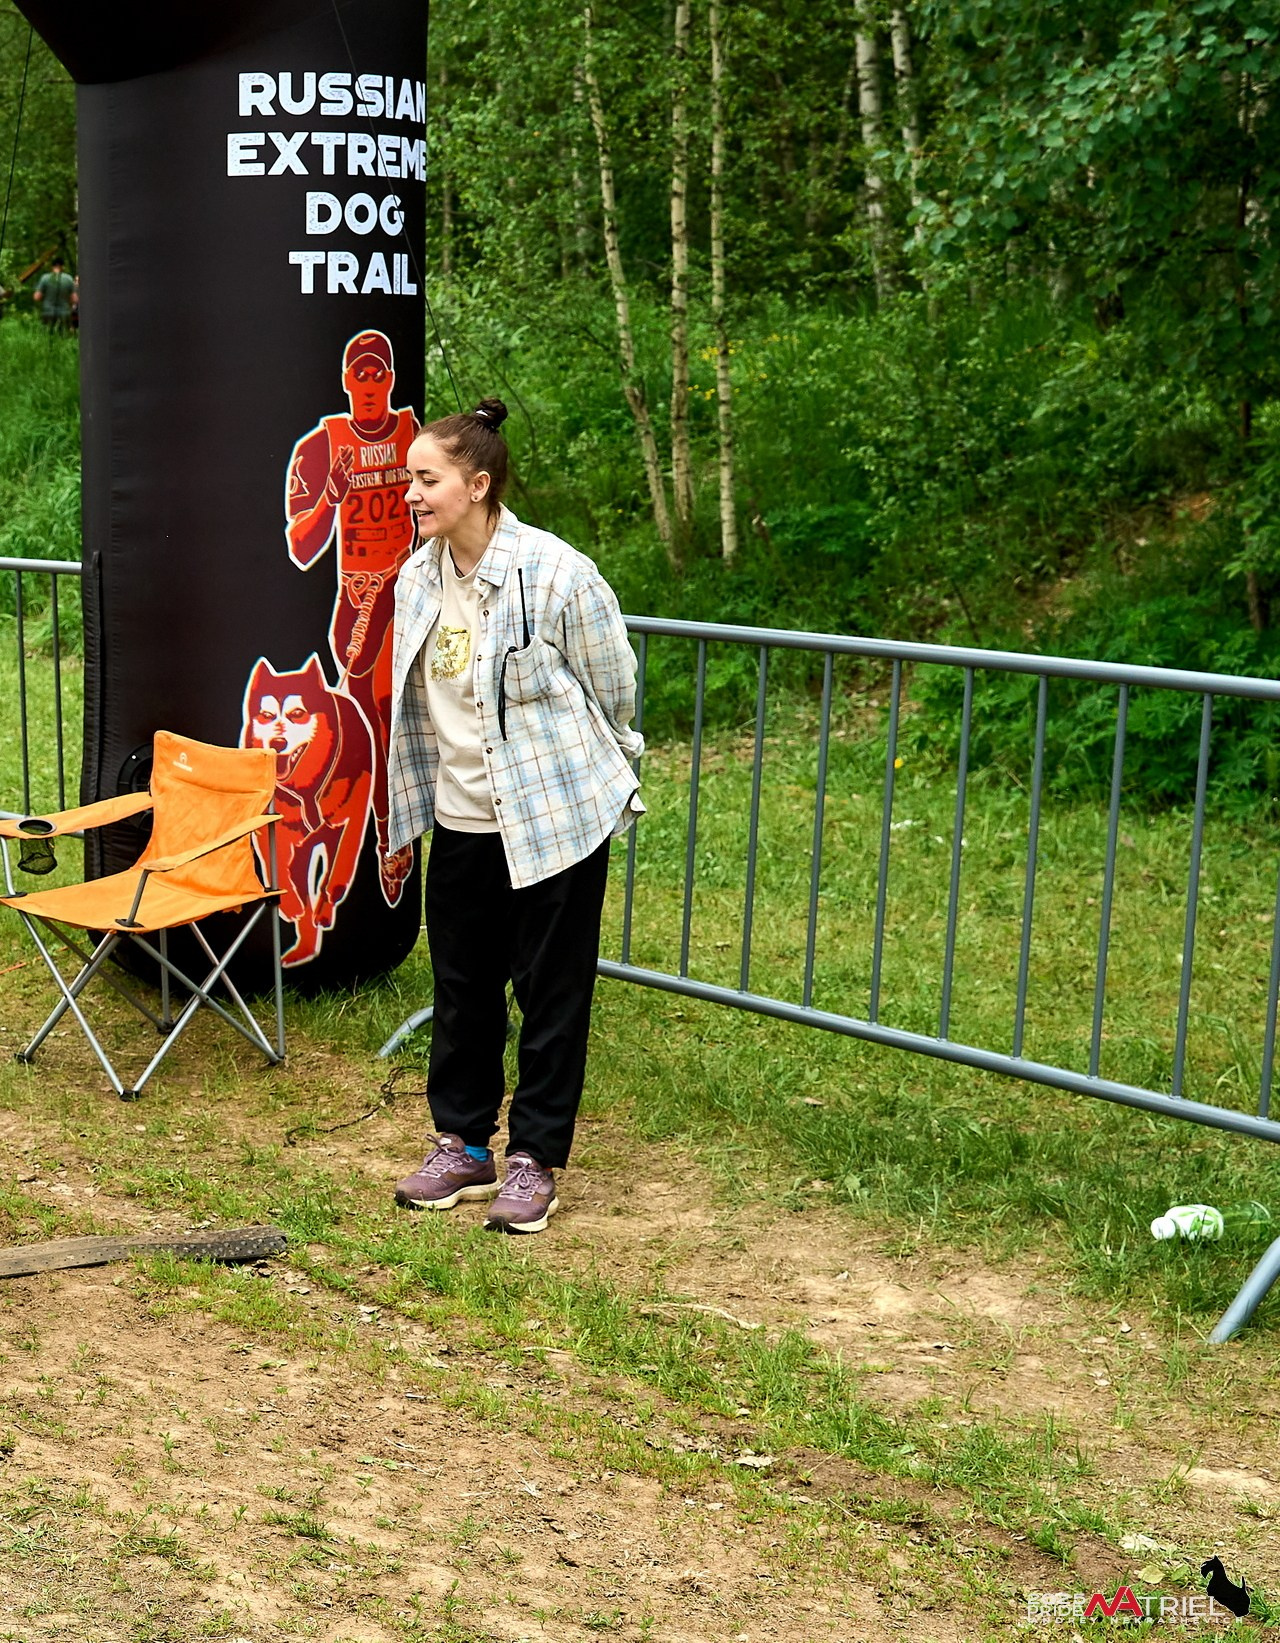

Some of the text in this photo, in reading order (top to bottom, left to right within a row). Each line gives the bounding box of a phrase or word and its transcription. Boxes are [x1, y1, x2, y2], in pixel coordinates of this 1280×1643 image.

[238, 72, 425, 124] RUSSIAN
[227, 131, 426, 182] EXTREME
[305, 191, 405, 236] DOG
[288, 251, 417, 295] TRAIL
[360, 442, 397, 468] RUSSIAN
